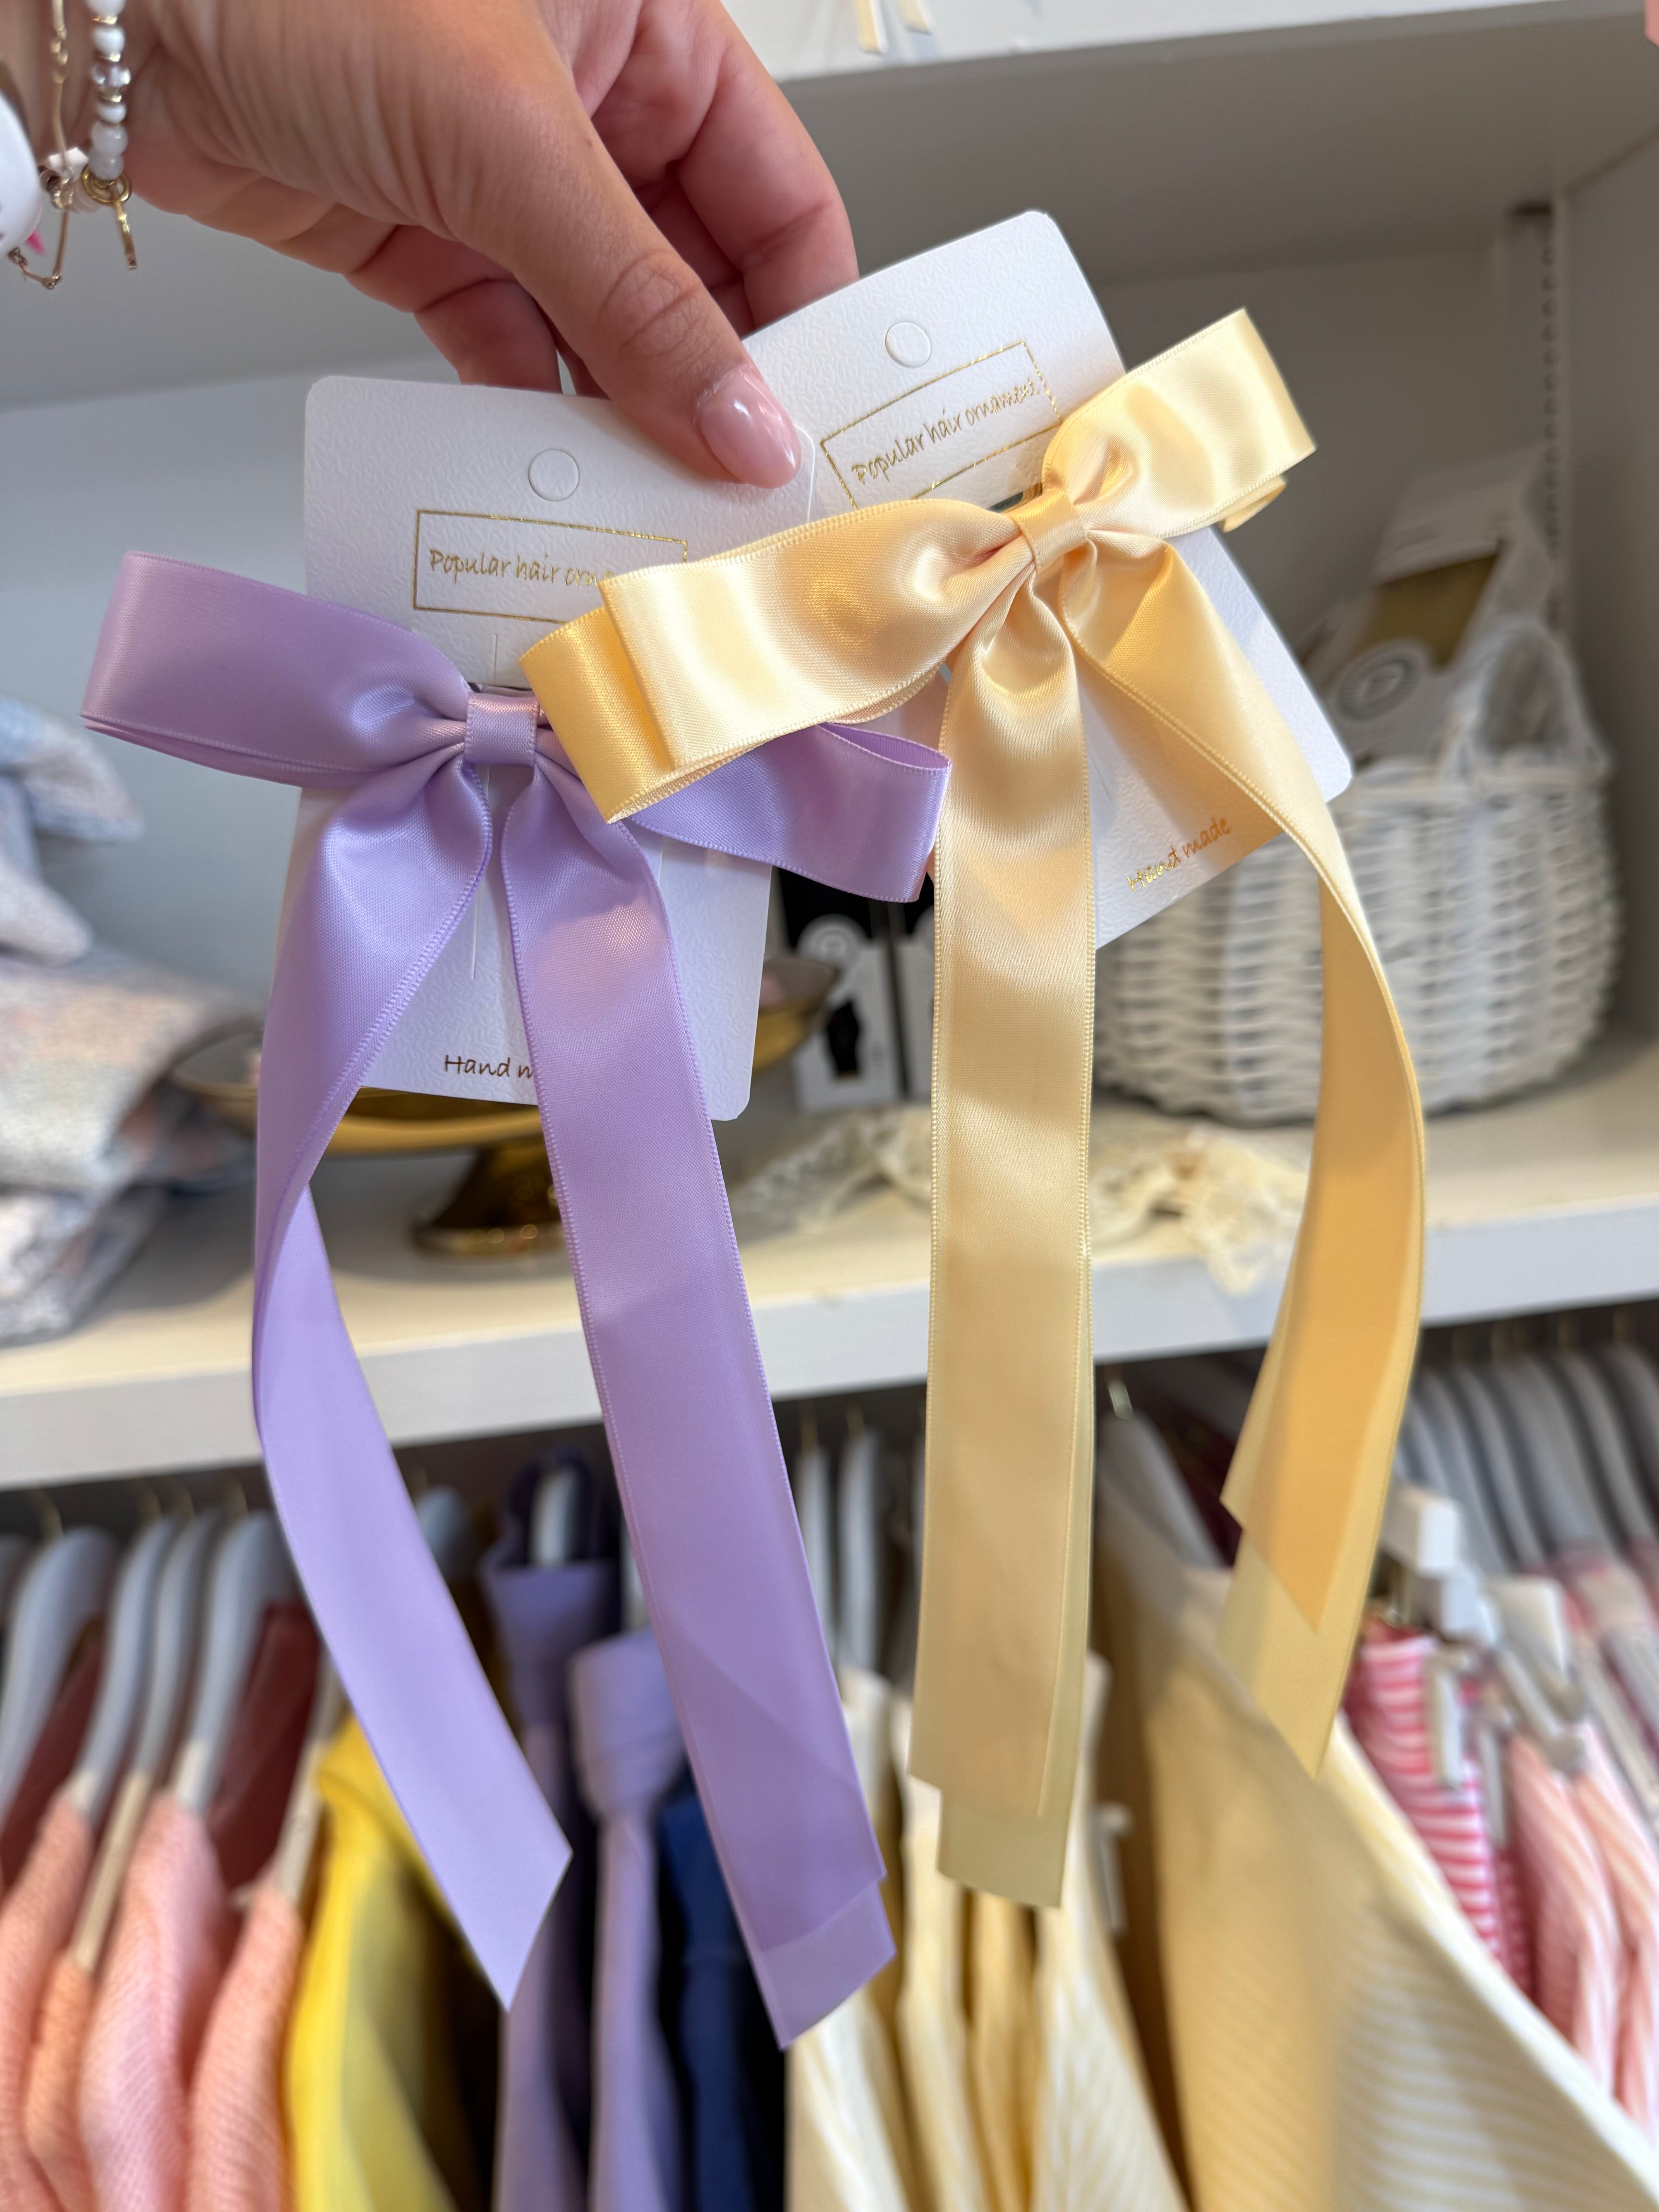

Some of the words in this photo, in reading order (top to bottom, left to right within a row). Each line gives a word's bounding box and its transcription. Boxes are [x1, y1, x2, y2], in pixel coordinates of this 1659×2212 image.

[851, 433, 924, 484] Popular
[923, 409, 961, 444] hair
[430, 549, 511, 585] Popular
[516, 554, 561, 583] hair
[1127, 844, 1181, 892] Hand
[1182, 817, 1231, 858] made
[445, 1055, 510, 1077] Hand
